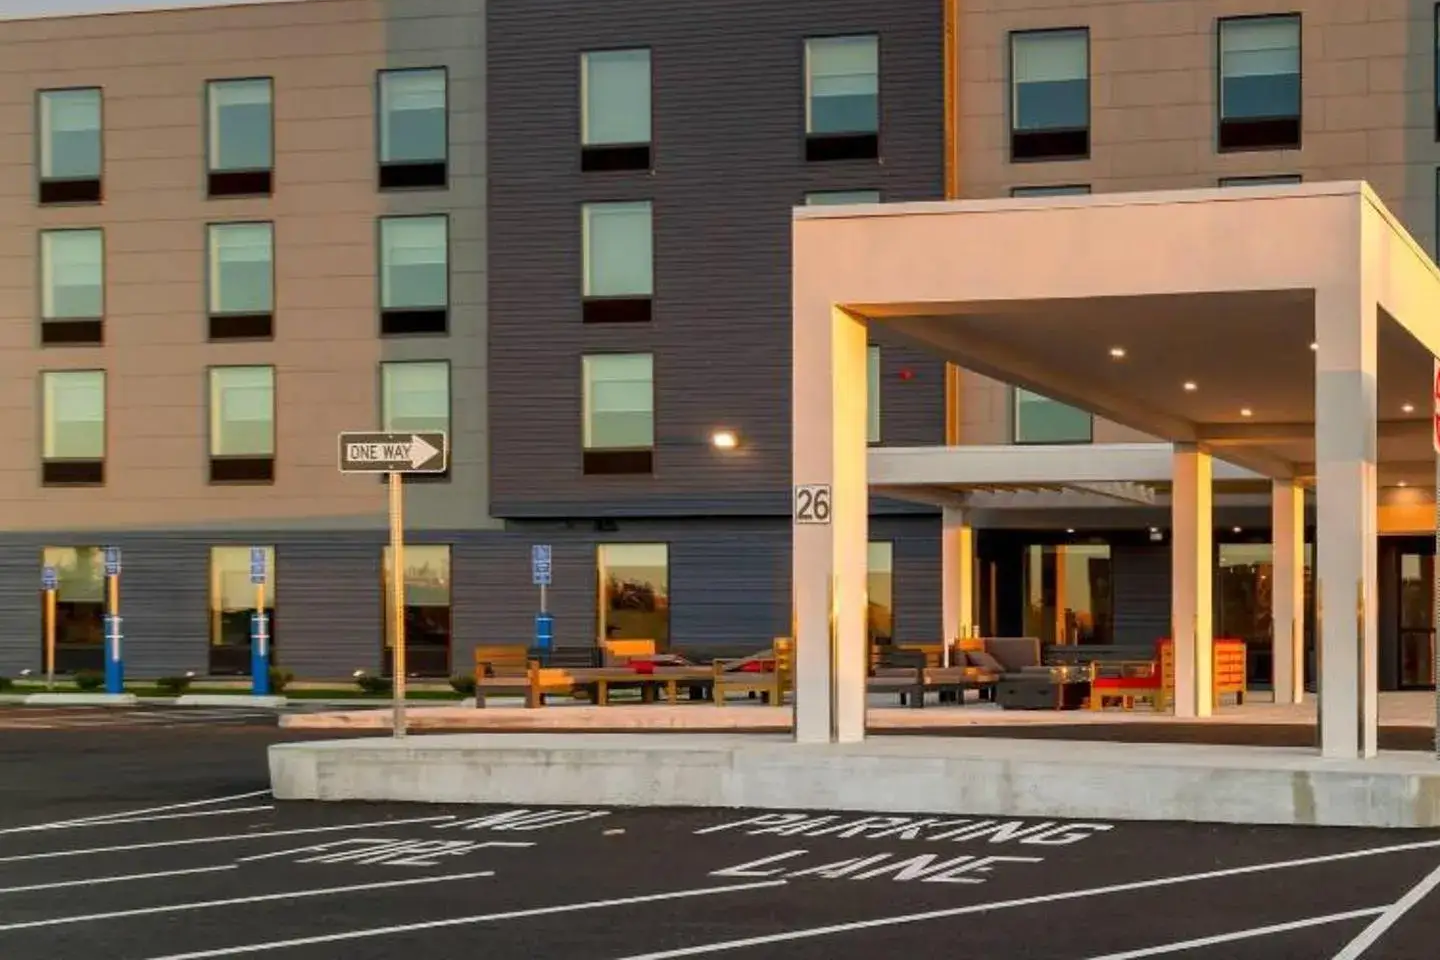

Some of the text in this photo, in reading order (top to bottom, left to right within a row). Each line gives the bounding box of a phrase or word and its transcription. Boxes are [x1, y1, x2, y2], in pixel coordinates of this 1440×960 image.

[351, 444, 411, 460] ONE WAY
[798, 489, 829, 520] 26
[432, 809, 1116, 846] NO PARKING
[236, 838, 1045, 884] FIRE LANE
